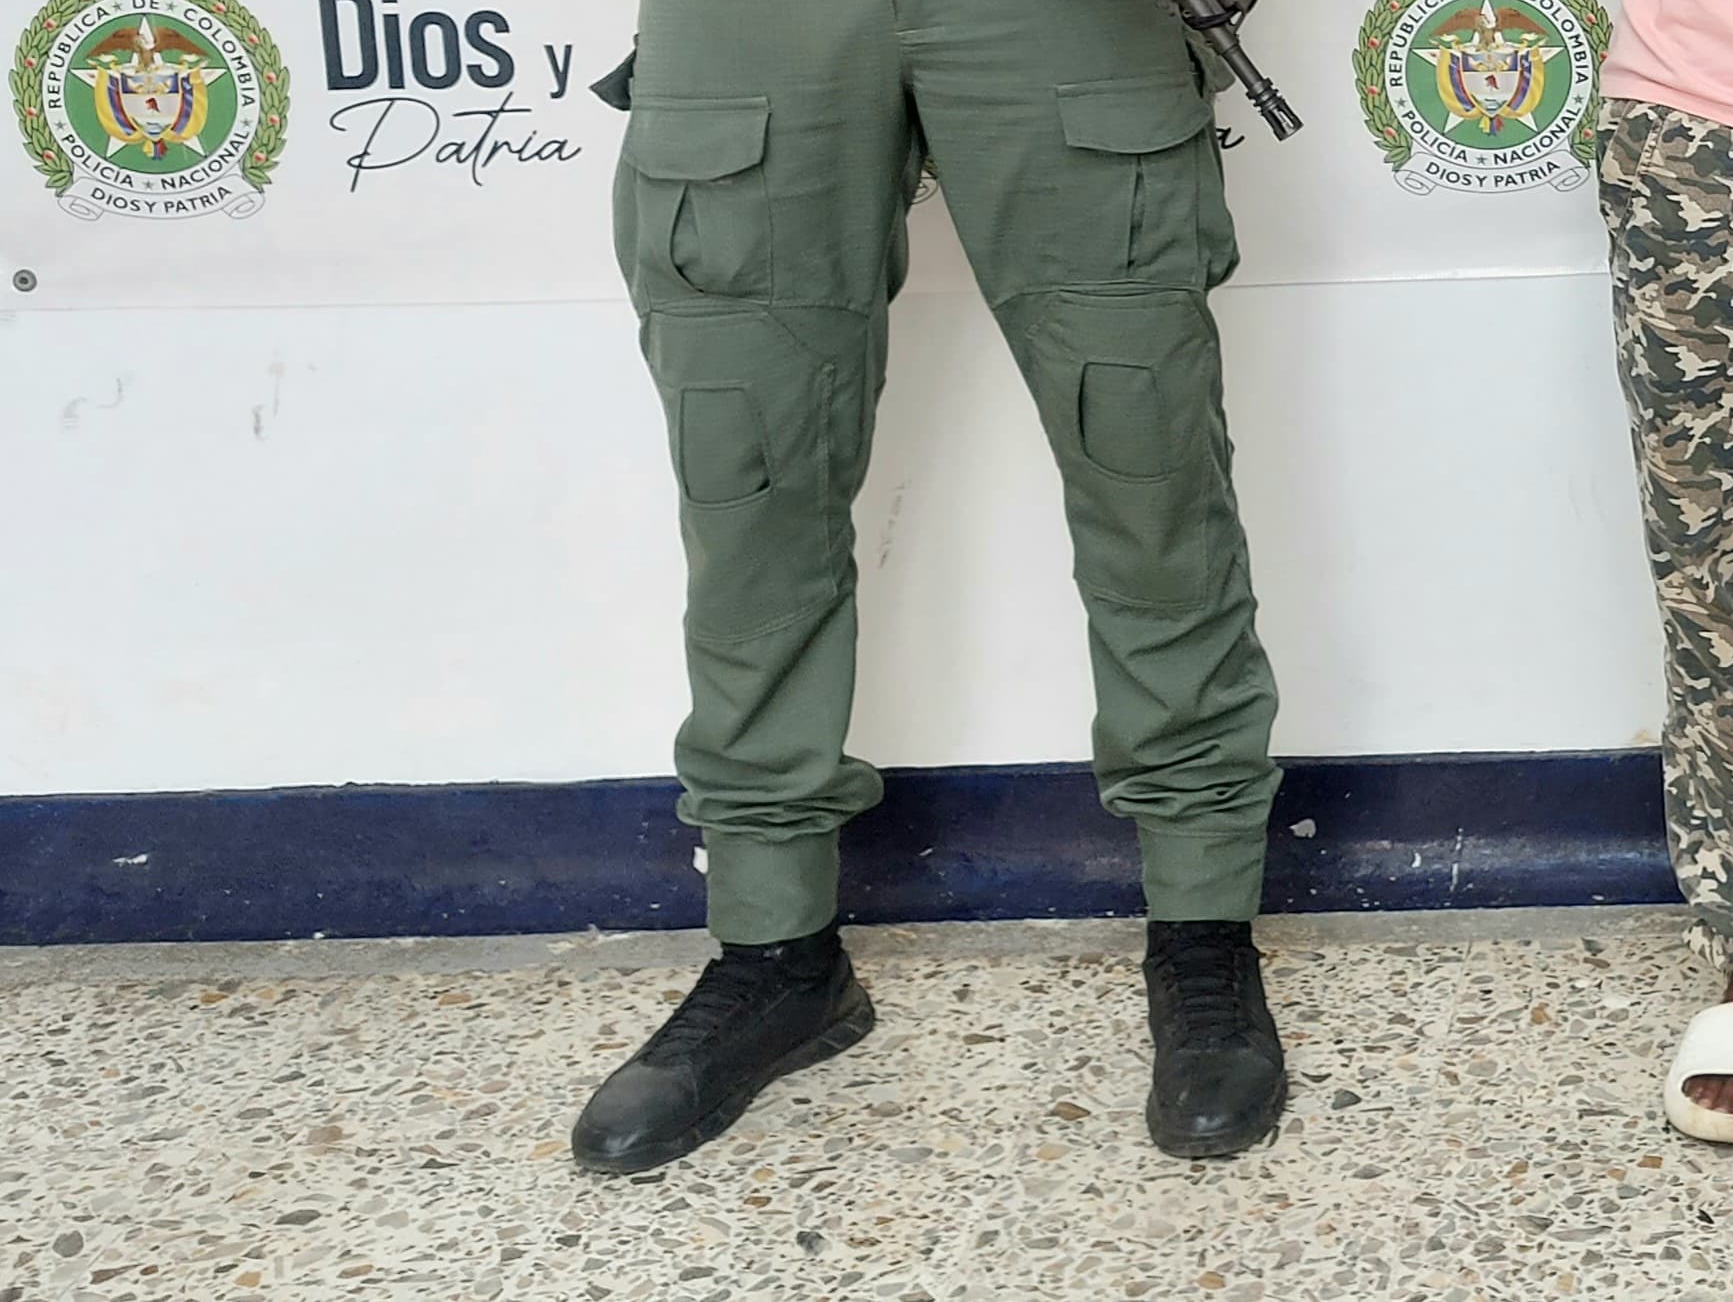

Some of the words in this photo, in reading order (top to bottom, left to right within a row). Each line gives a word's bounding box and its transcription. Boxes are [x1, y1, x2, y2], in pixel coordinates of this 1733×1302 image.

[184, 8, 256, 108] COLOMBIA
[545, 42, 573, 99] y
[162, 132, 248, 191] NACIONAL
[329, 92, 583, 193] Patria
[1494, 108, 1581, 165] NACIONAL
[164, 185, 232, 214] PATRIA
[1493, 161, 1559, 189] PATRIA
